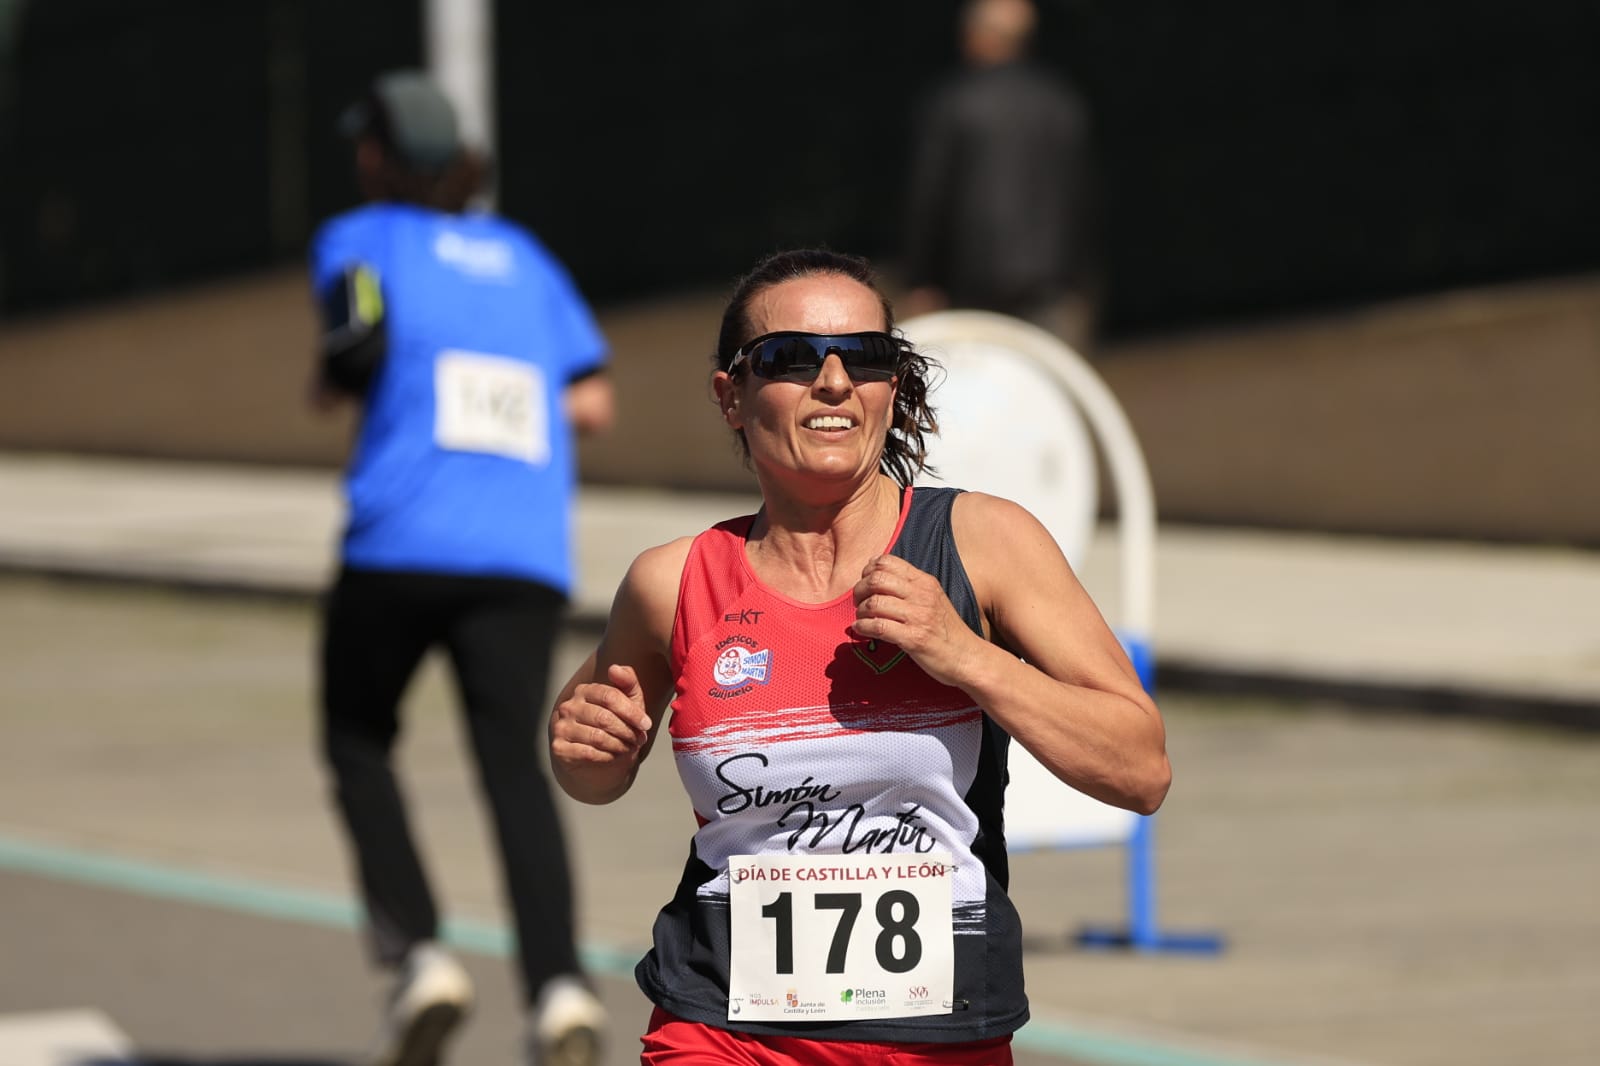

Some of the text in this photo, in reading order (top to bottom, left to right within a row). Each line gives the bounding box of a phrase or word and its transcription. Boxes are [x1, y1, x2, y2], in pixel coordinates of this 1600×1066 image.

[724, 608, 765, 625] EKT
[708, 685, 753, 700] Guijuelo
[716, 753, 841, 814] Simón
[777, 801, 936, 855] Martín
[738, 862, 945, 881] DÍA DE CASTILLA Y LEÓN
[762, 889, 922, 975] 178
[855, 988, 886, 999] Plena
